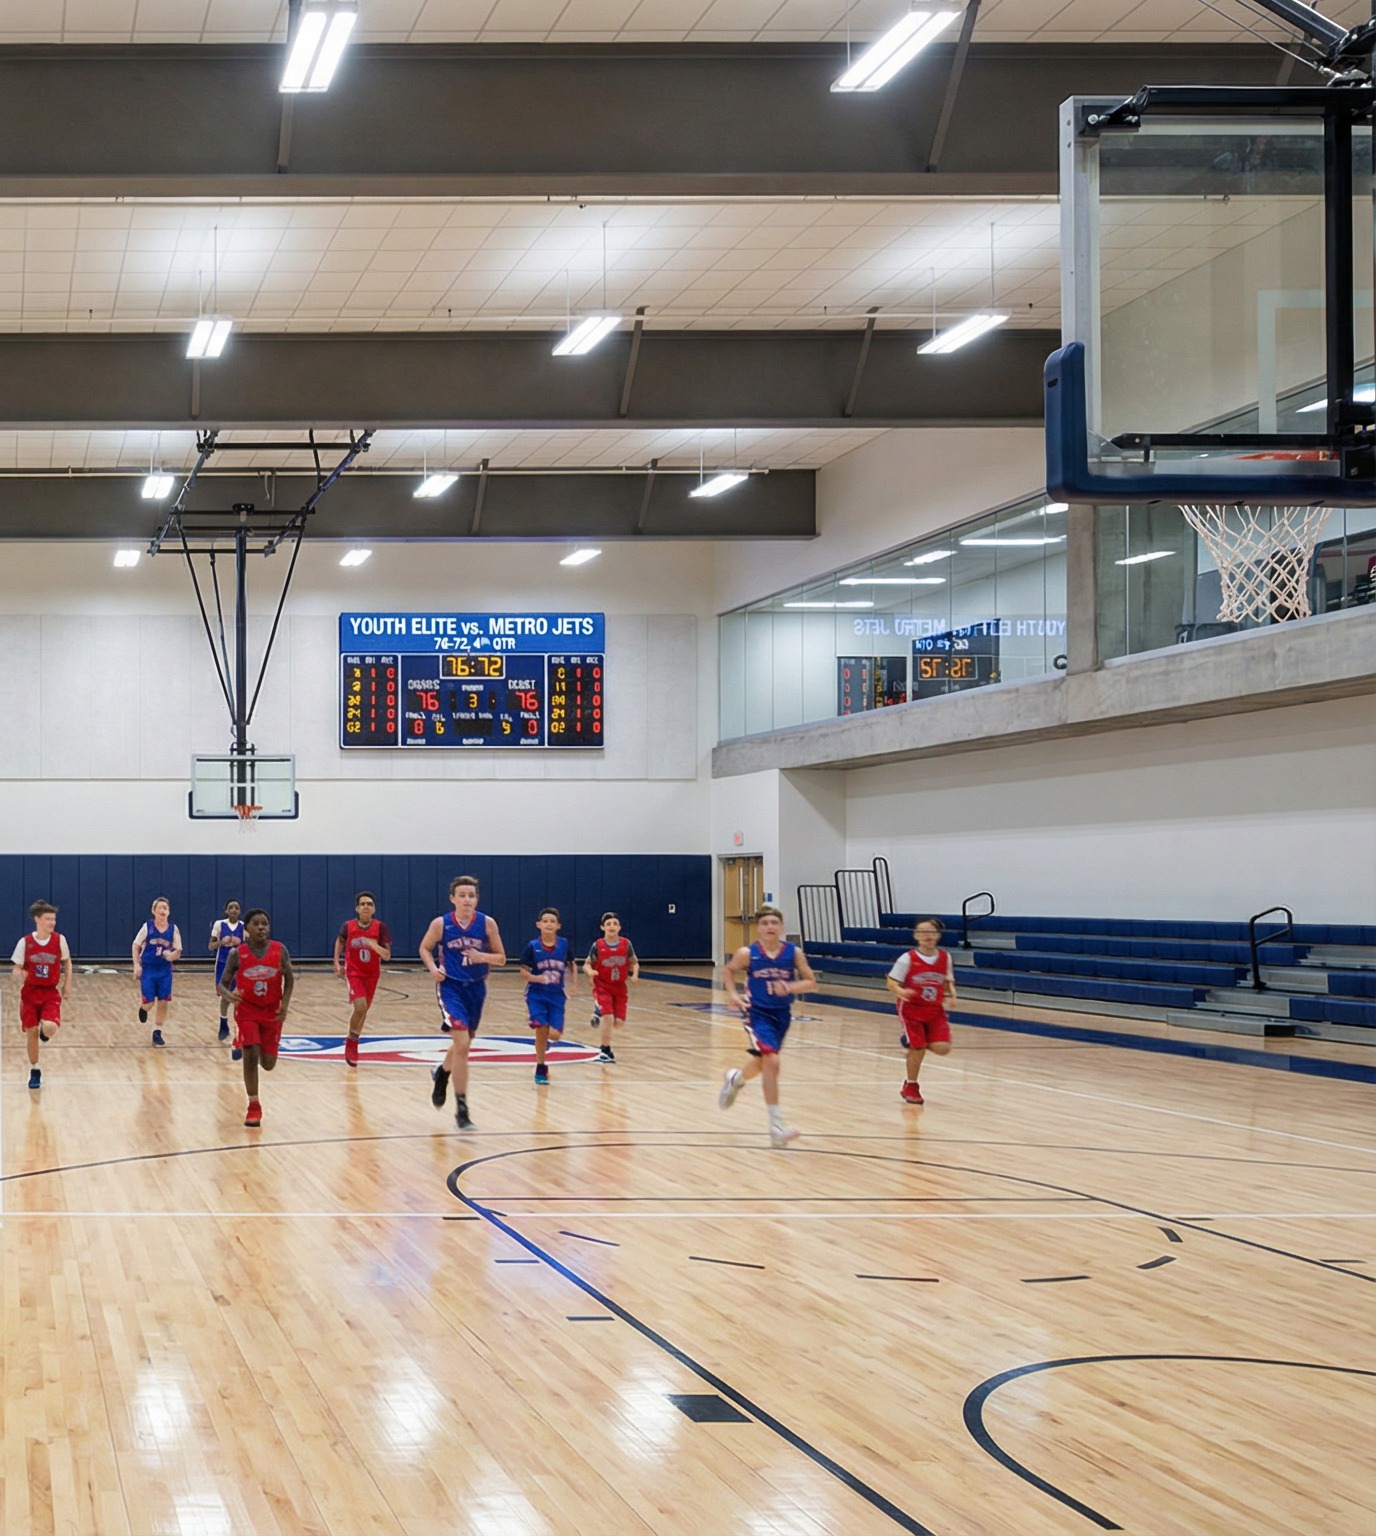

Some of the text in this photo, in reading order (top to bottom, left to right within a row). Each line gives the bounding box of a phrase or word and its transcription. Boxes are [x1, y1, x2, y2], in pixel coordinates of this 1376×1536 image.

[350, 617, 594, 635] YOUTH ELITE vs. METRO JETS
[492, 637, 516, 650] QTR
[446, 656, 502, 677] 76:72
[416, 691, 439, 711] 76
[515, 691, 539, 711] 76
